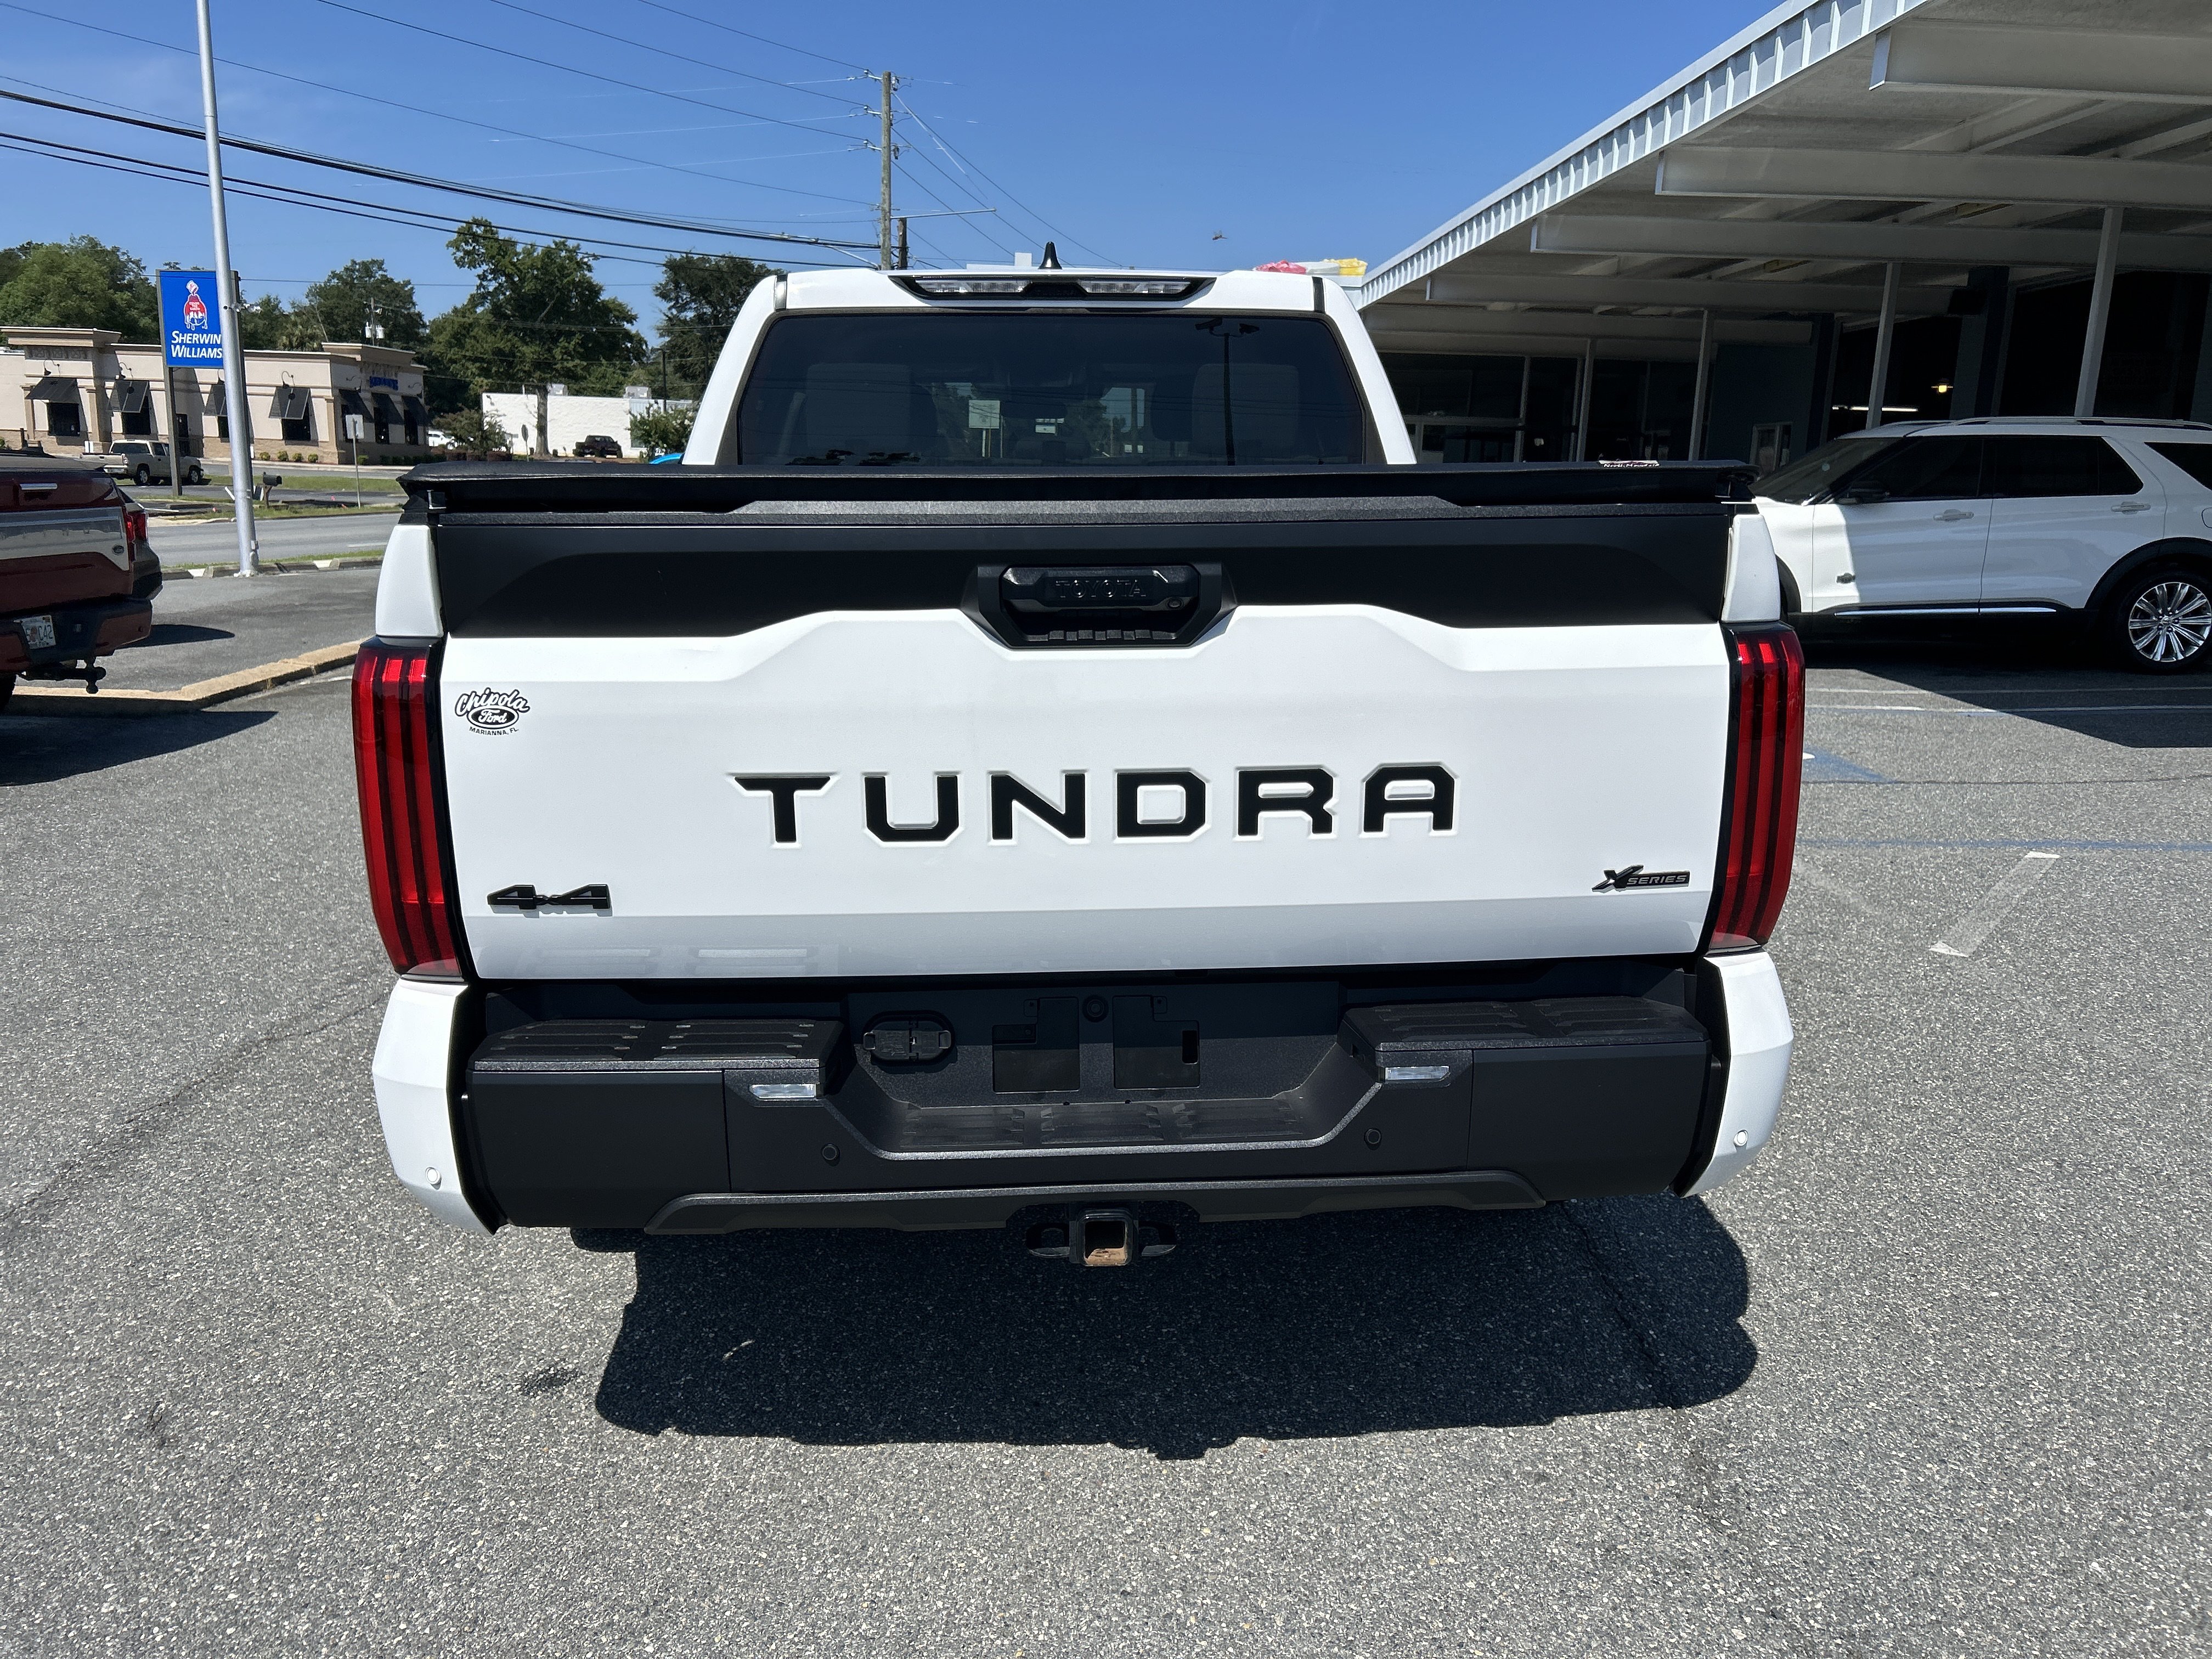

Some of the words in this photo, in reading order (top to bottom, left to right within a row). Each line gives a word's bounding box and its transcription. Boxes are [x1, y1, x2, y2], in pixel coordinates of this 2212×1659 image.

[171, 331, 221, 345] SHERWIN
[171, 345, 223, 359] WILLIAMS
[1056, 579, 1147, 598] TOYOTA
[455, 687, 531, 717] Chipola
[478, 709, 507, 723] Ford
[735, 765, 1455, 843] TUNDRA
[1627, 875, 1688, 885] SERIES
